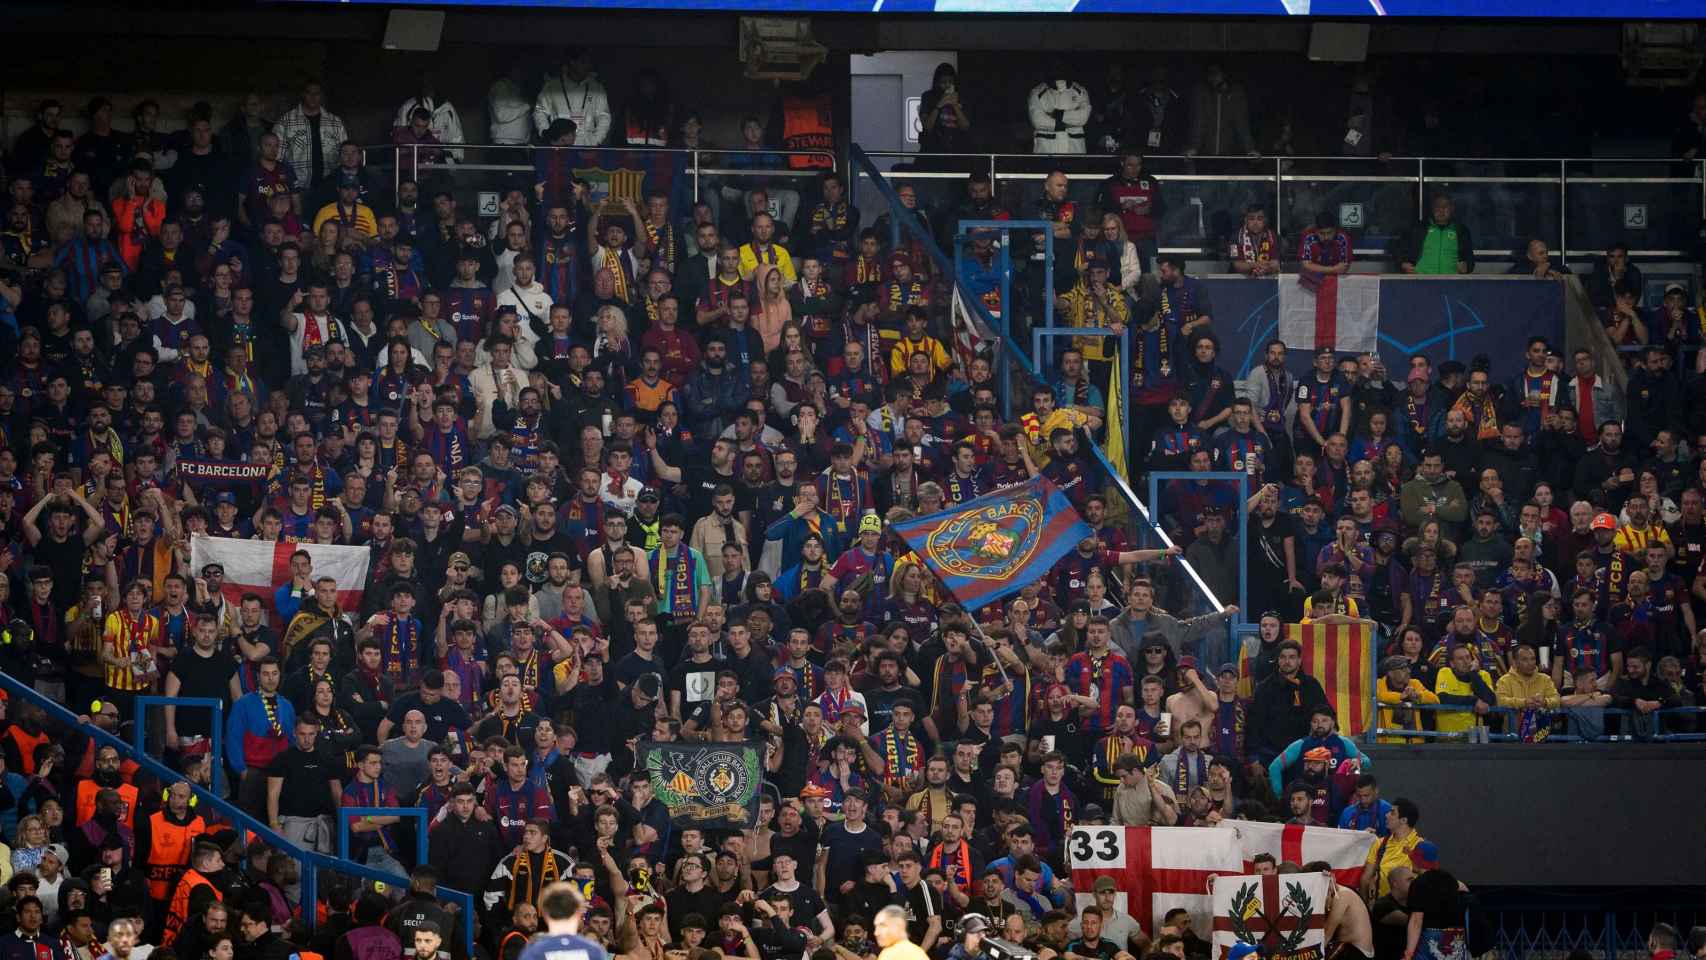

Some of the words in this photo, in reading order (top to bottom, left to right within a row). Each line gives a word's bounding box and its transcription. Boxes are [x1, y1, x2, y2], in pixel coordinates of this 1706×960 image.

[181, 463, 195, 475] FC
[198, 464, 267, 477] BARCELONA
[1071, 831, 1120, 861] 33
